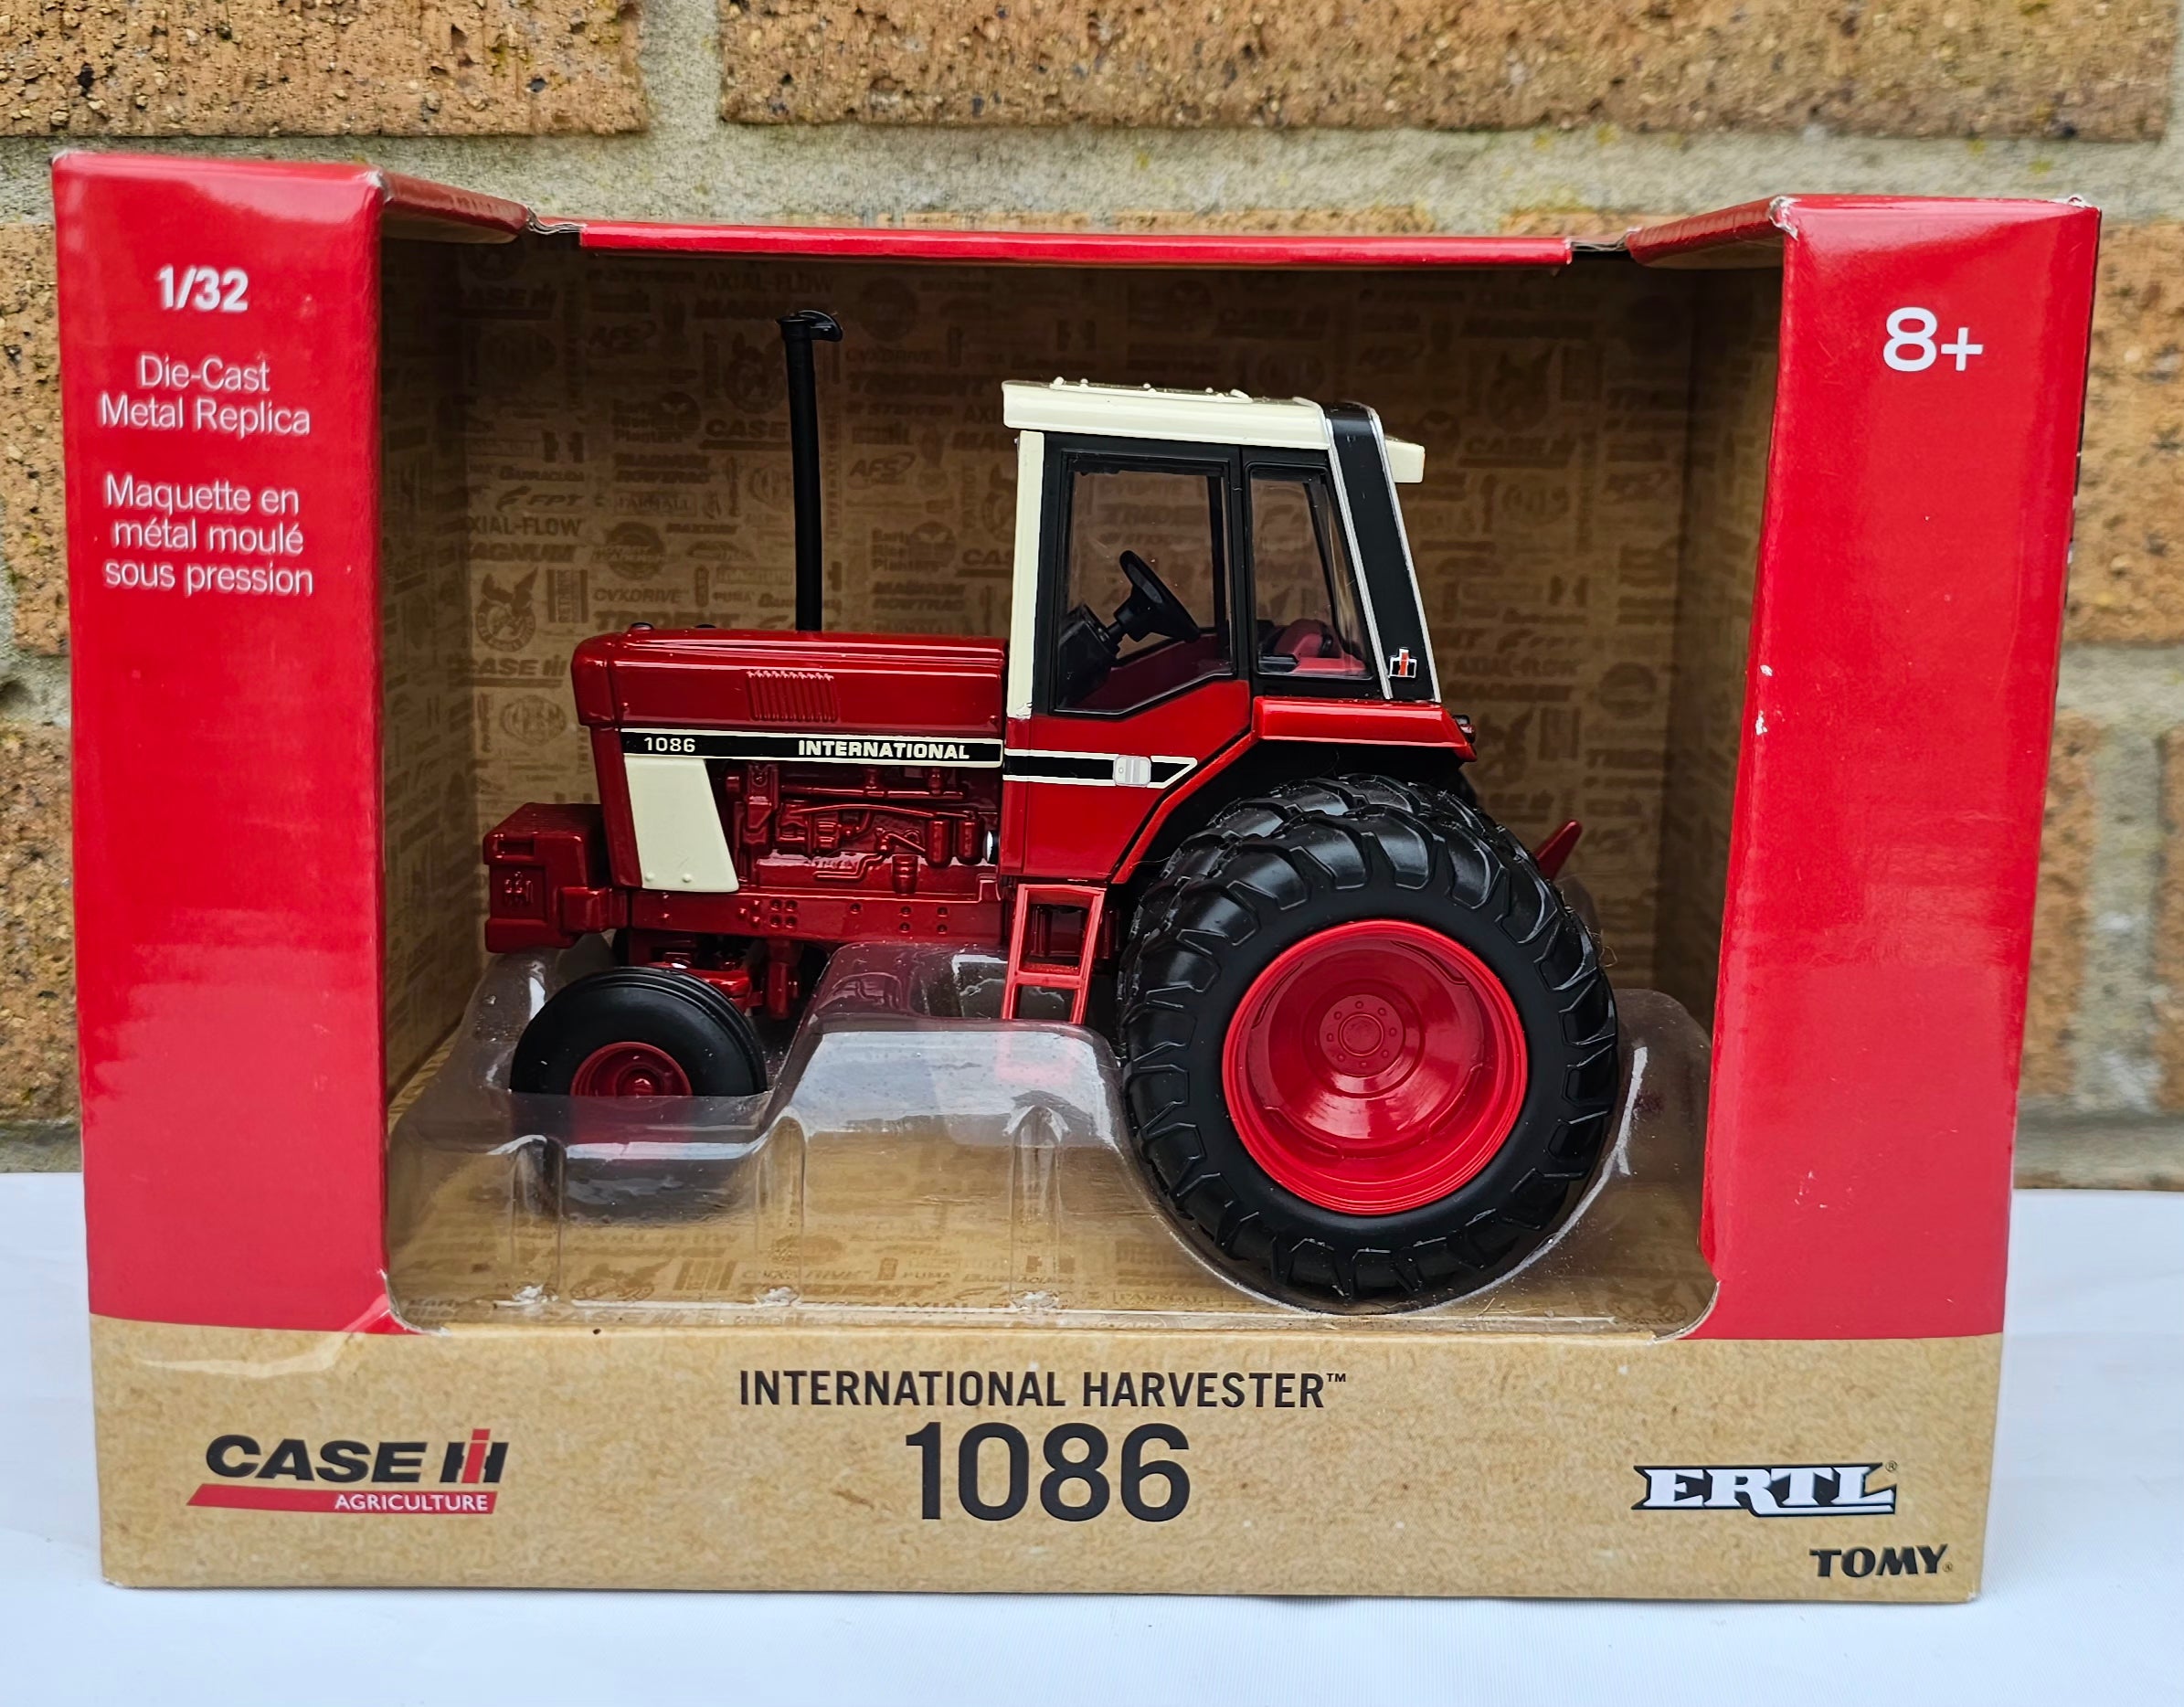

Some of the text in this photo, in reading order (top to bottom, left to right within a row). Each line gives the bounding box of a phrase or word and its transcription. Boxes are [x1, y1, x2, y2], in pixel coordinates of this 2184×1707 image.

[156, 265, 249, 312] 1/32
[1882, 307, 1985, 372] 8+
[140, 354, 271, 393] Die-Cast
[99, 392, 311, 440] Metal Replica
[103, 472, 299, 515] Maquette en
[111, 518, 304, 556] métal moulé
[104, 561, 314, 597] sous pression
[643, 736, 970, 760] 1086 INTERNATIONAL
[739, 1370, 1066, 1408] INTERNATIONAL
[205, 1434, 429, 1484] CASE
[905, 1421, 1191, 1523] 1086
[334, 1492, 490, 1513] AGRICULTURE
